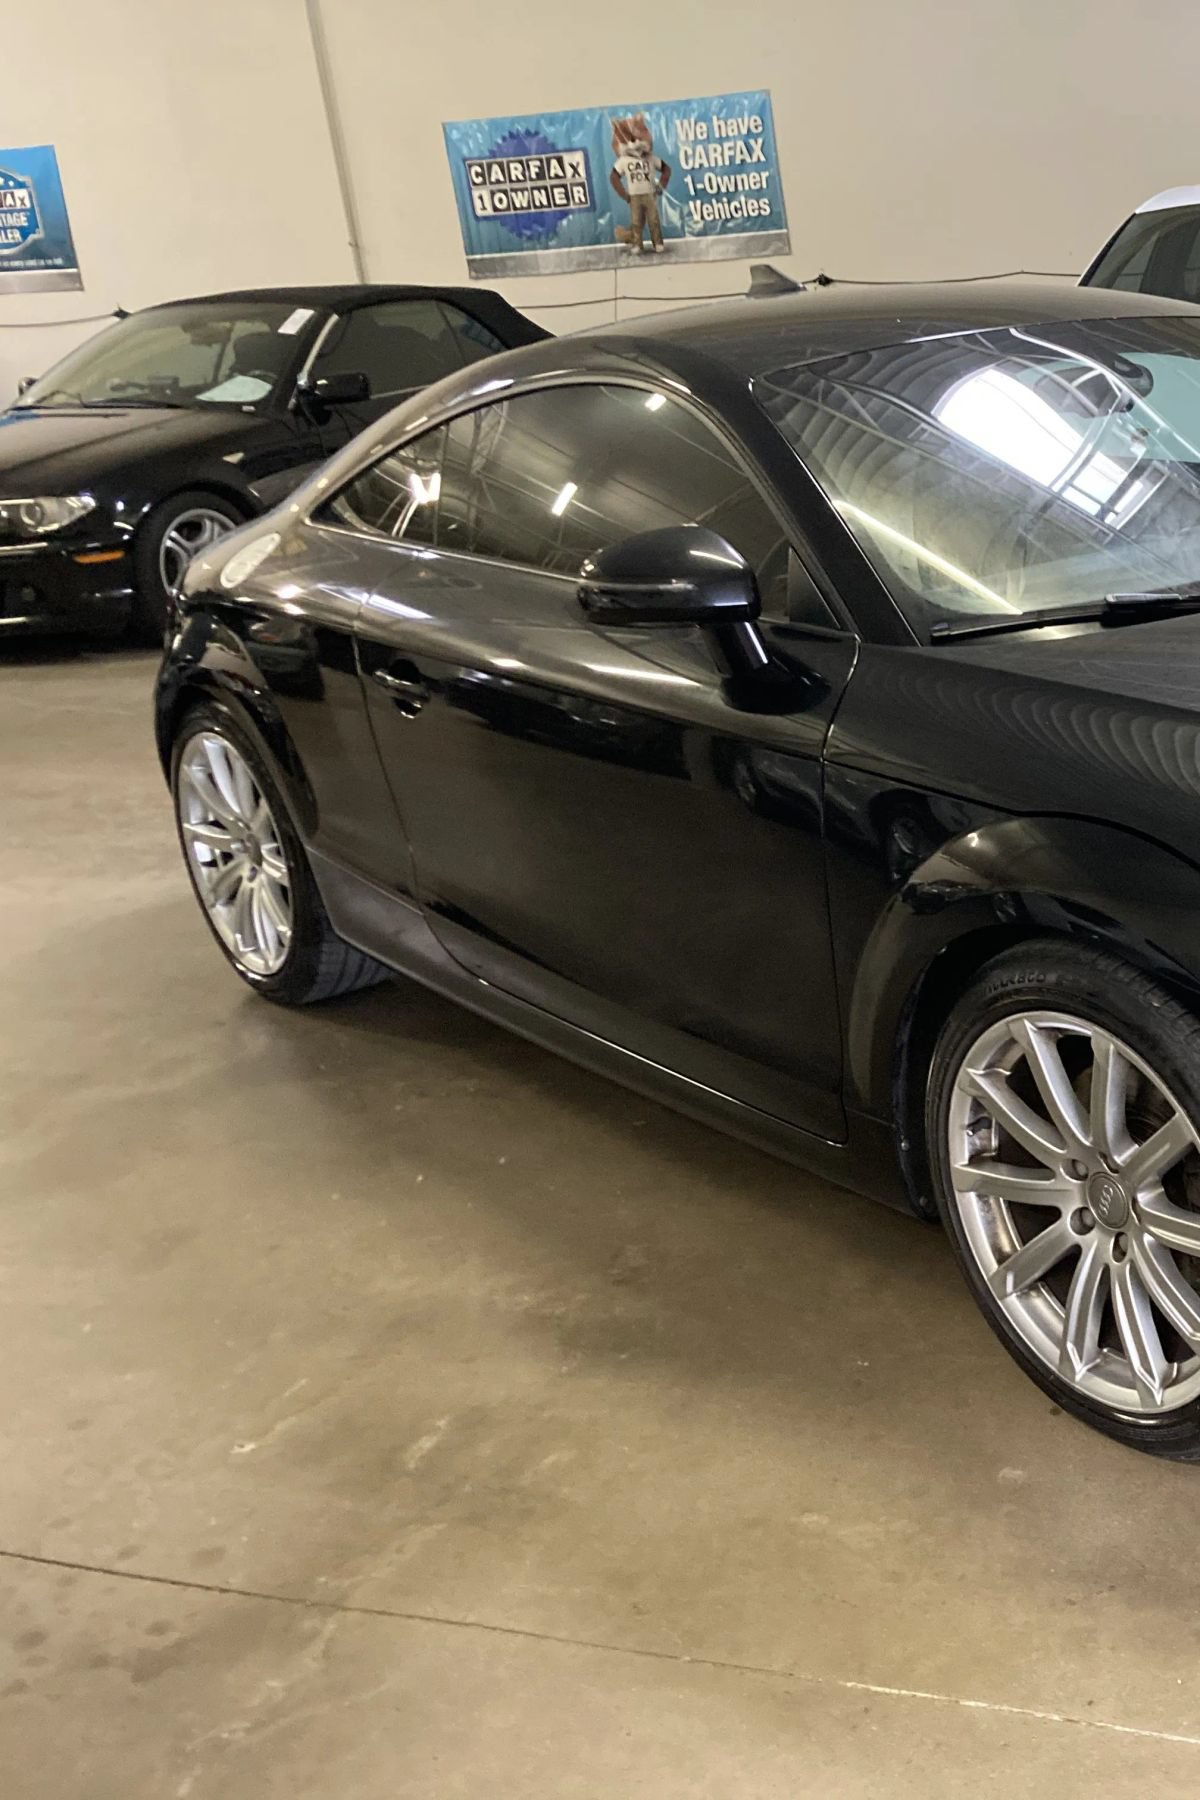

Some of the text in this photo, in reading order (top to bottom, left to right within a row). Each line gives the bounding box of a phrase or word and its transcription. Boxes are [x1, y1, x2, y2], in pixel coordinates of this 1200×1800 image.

[675, 115, 763, 141] We have
[679, 138, 766, 170] CARFAX
[471, 158, 582, 184] CARFAX
[684, 171, 770, 196] 1-Owner
[689, 195, 771, 221] Vehicles
